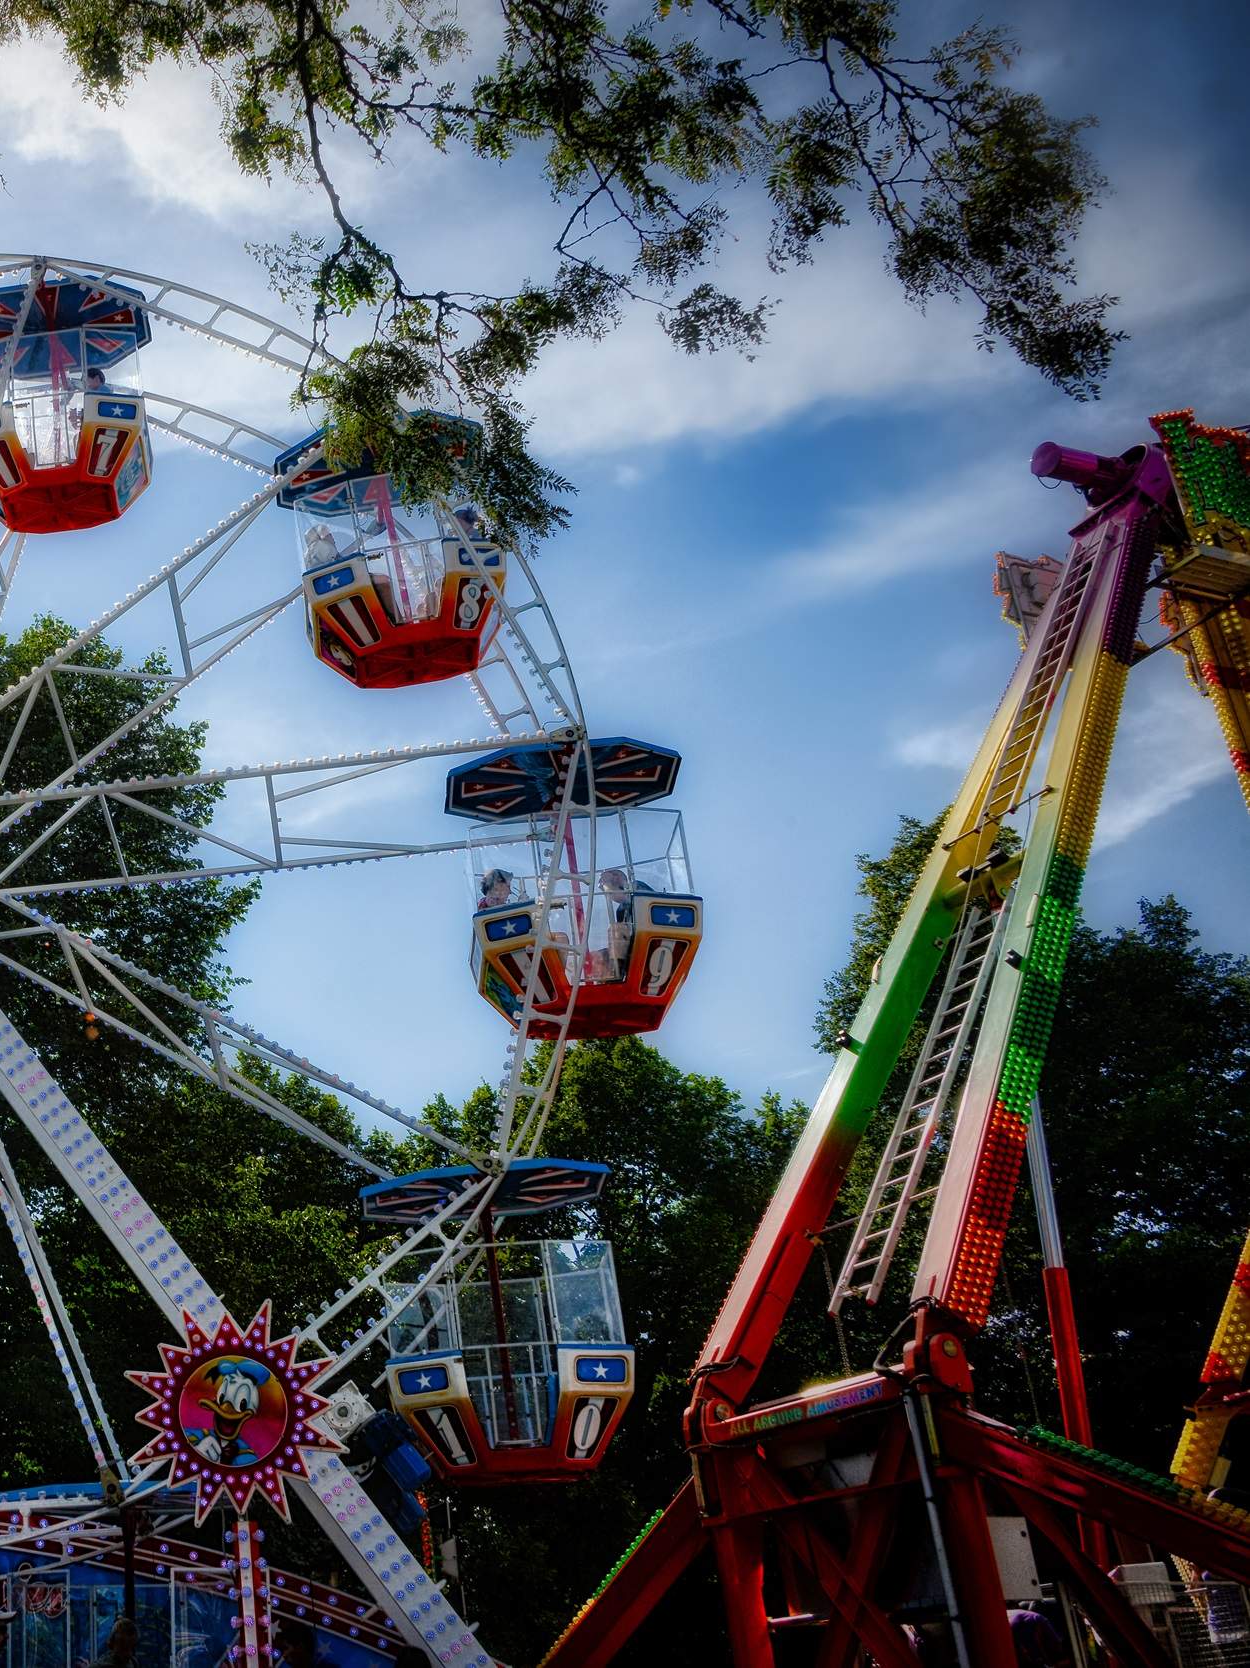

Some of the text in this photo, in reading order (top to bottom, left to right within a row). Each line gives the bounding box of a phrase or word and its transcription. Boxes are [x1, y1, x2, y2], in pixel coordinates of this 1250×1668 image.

[96, 434, 118, 472] 7
[458, 584, 481, 622] 8
[649, 945, 673, 984] 9
[730, 1419, 751, 1437] ALL
[753, 1407, 802, 1432] AROUND
